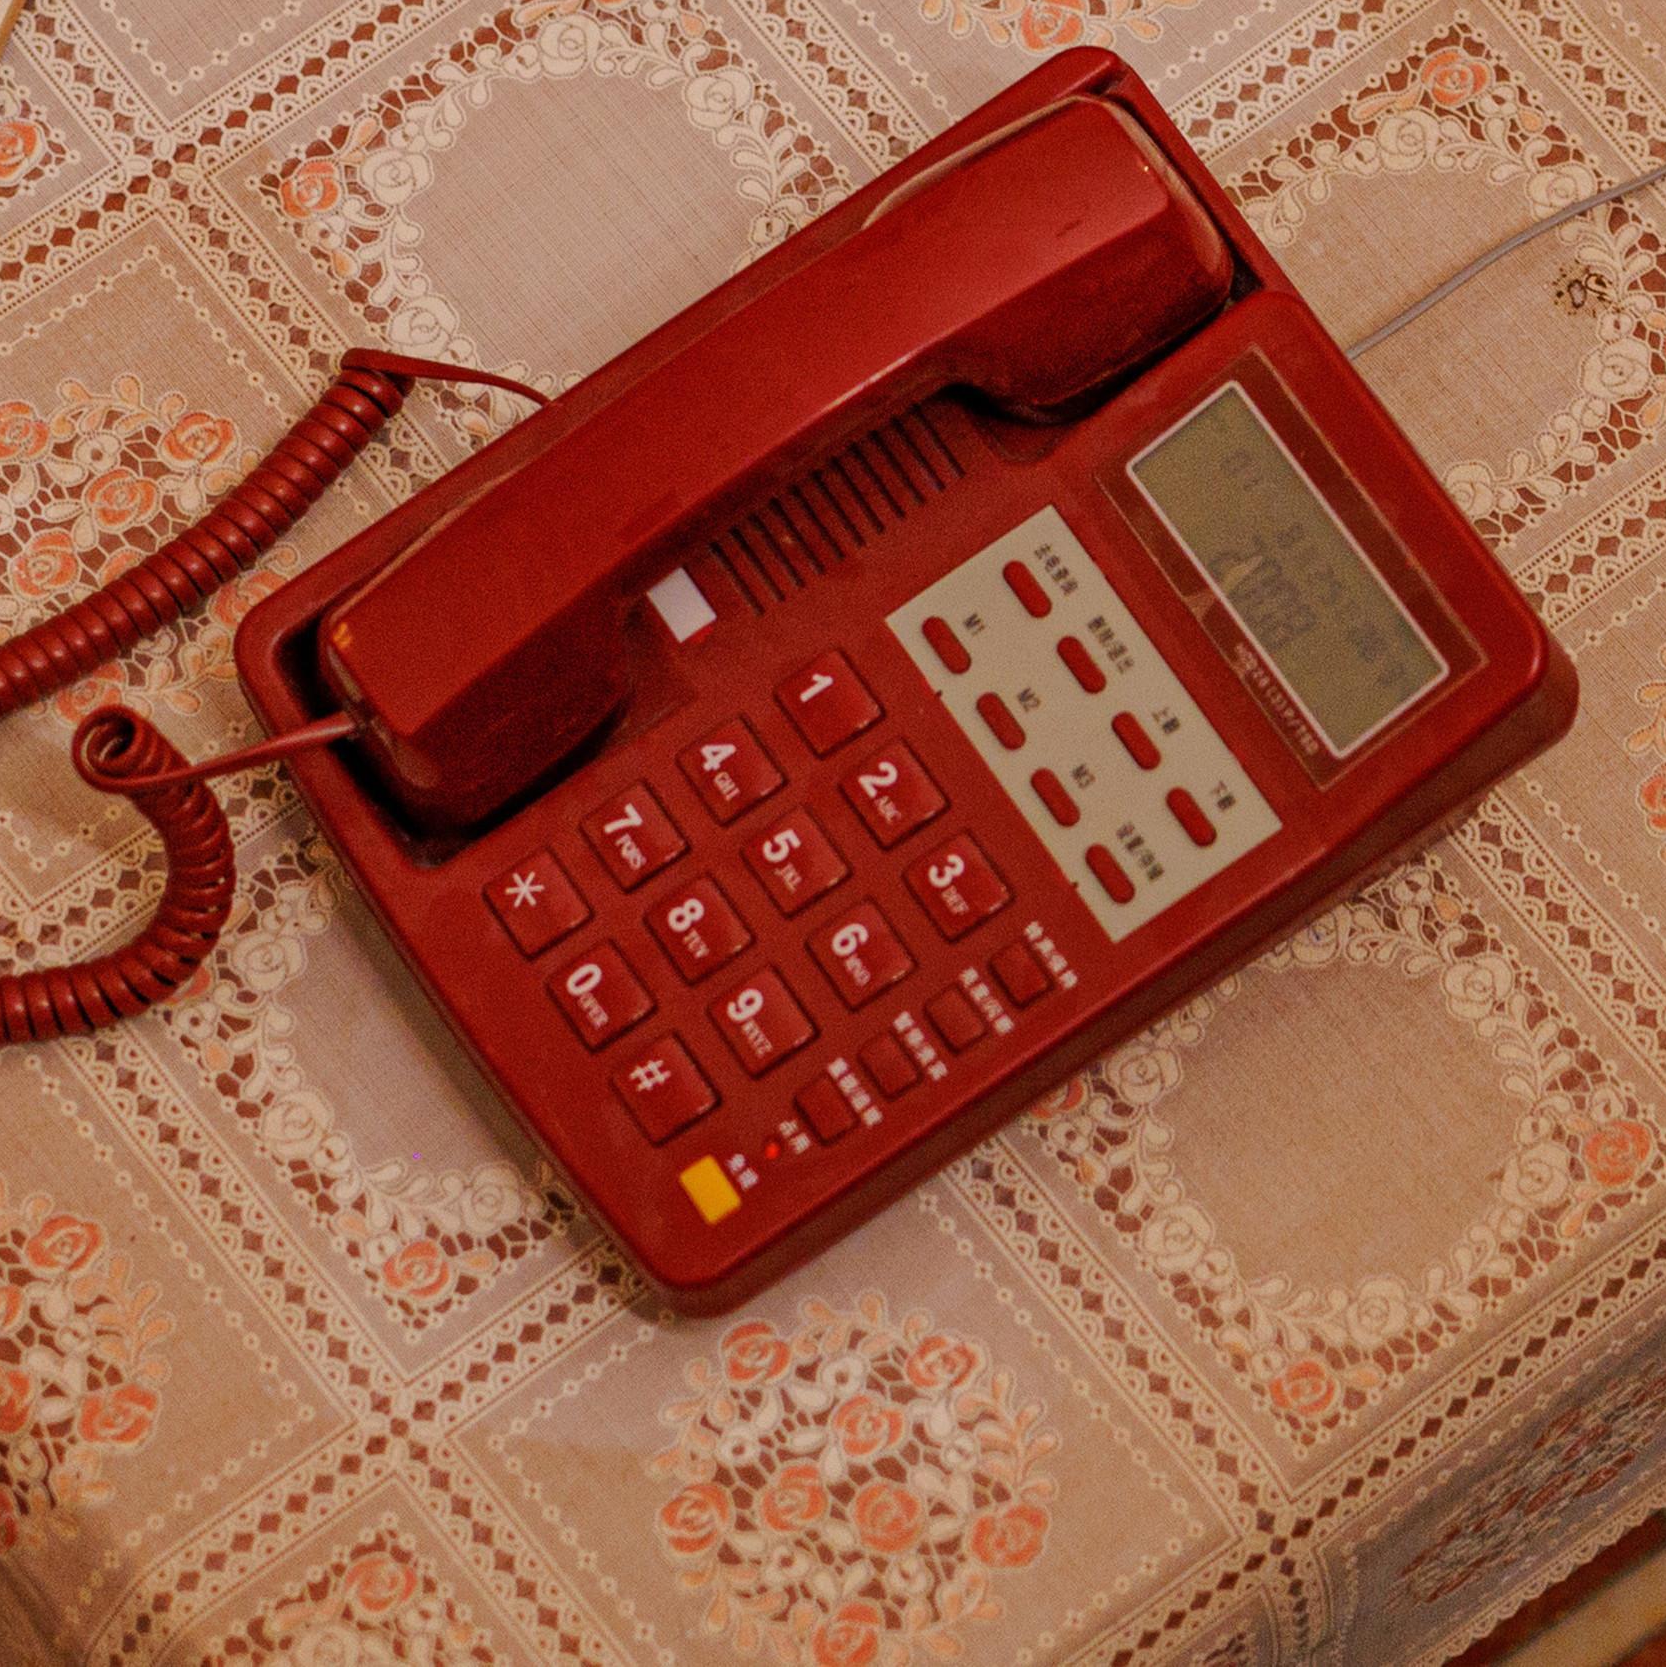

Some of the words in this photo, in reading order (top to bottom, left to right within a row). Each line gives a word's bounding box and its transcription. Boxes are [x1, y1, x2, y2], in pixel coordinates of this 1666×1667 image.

[962, 612, 990, 637] M1
[800, 673, 834, 703] 1
[1016, 687, 1041, 713] M2
[700, 743, 737, 771] 4
[713, 771, 740, 801] GHI
[858, 761, 898, 798] 2
[1071, 764, 1095, 789] M3
[604, 803, 644, 834] 7
[875, 795, 901, 823] ABC
[762, 828, 801, 863] 5
[775, 863, 802, 892] JKL
[928, 854, 965, 888] 3
[941, 885, 969, 914] DEF
[667, 898, 705, 932] 8
[683, 929, 709, 958] TUV
[831, 923, 869, 956] 6
[566, 963, 603, 999] 0
[727, 988, 764, 1022] 9
[629, 1059, 671, 1091] #
